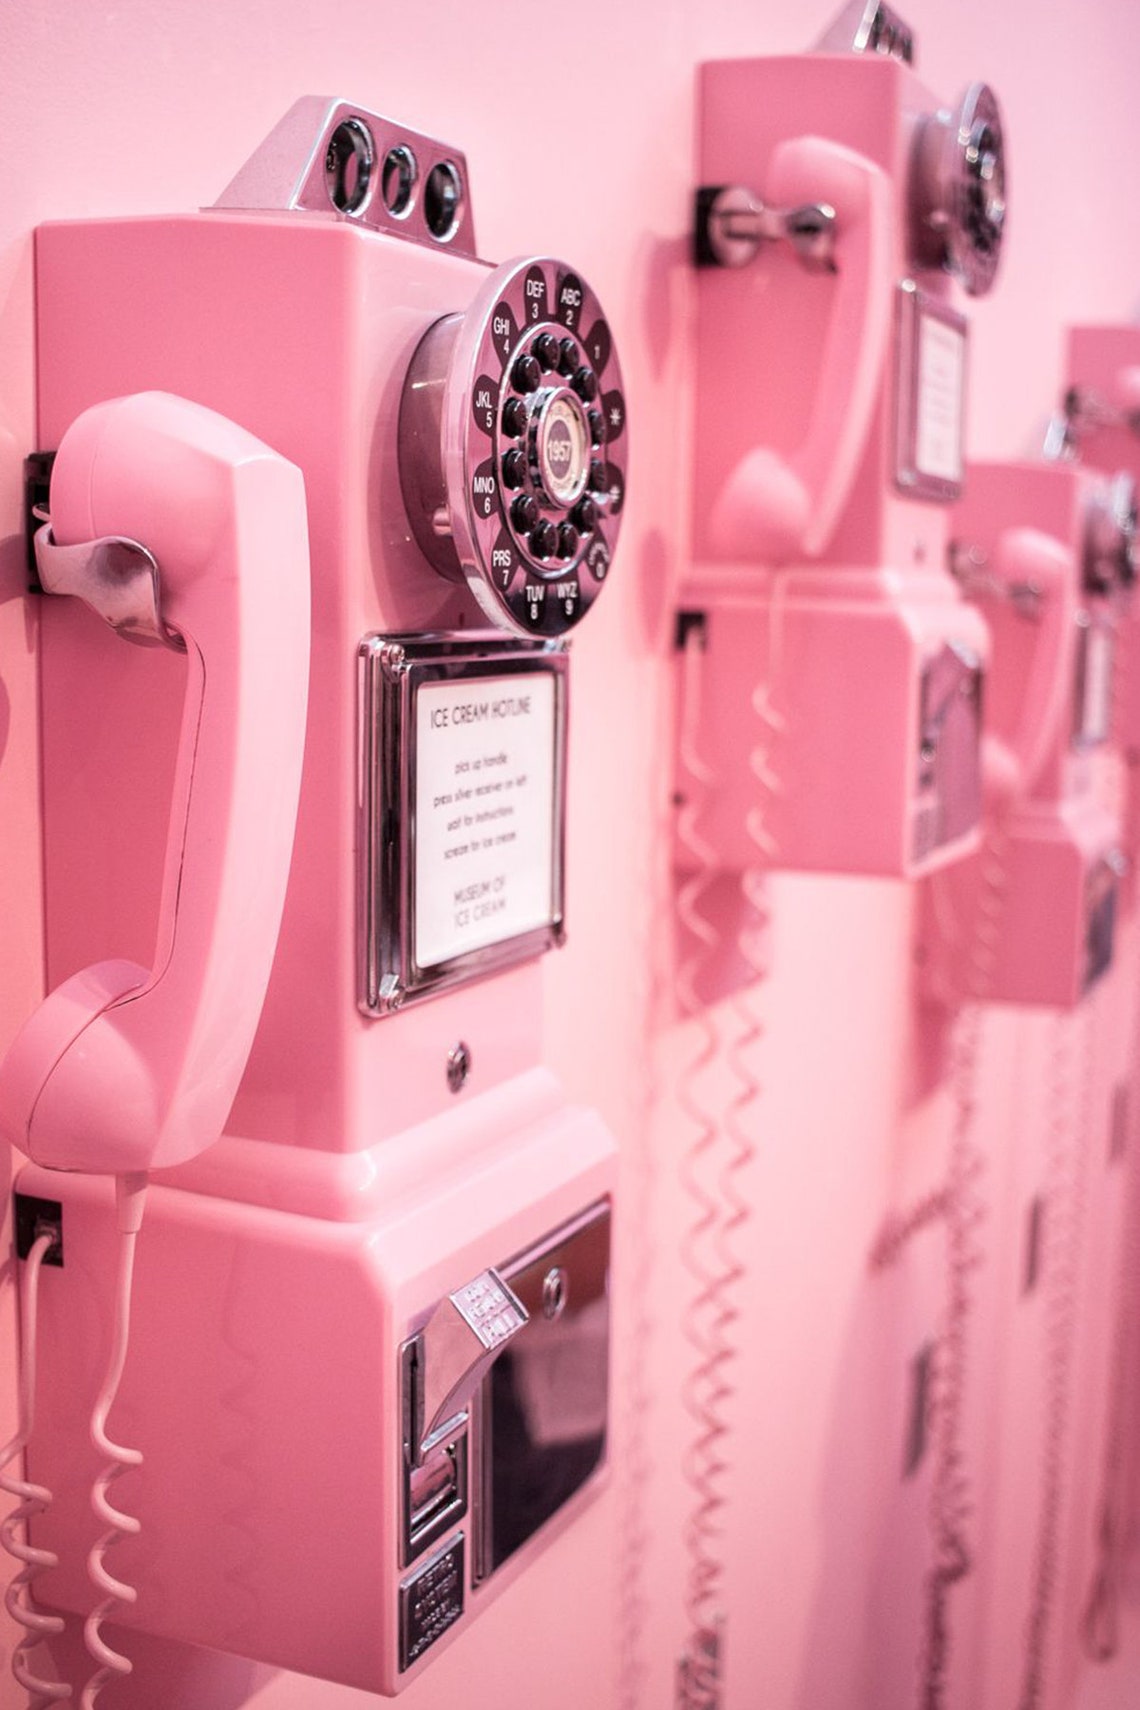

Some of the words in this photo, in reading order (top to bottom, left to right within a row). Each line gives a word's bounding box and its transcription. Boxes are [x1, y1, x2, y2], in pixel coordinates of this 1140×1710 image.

[526, 279, 545, 298] DEF
[560, 287, 581, 306] ABC
[531, 303, 539, 318] 3
[566, 310, 573, 325] 2
[493, 317, 510, 335] GHI
[503, 339, 510, 354] 4
[476, 391, 492, 409] JKL
[486, 412, 493, 428] 5
[473, 477, 495, 494] MNO
[484, 497, 491, 514] 6
[493, 550, 511, 567] PRS
[502, 570, 509, 586] 7
[526, 585, 544, 602] TUV
[531, 604, 538, 620] 8
[565, 600, 574, 616] 9
[430, 707, 449, 729] ICE
[451, 702, 489, 725] CREAM
[491, 696, 531, 719] HOTLINE
